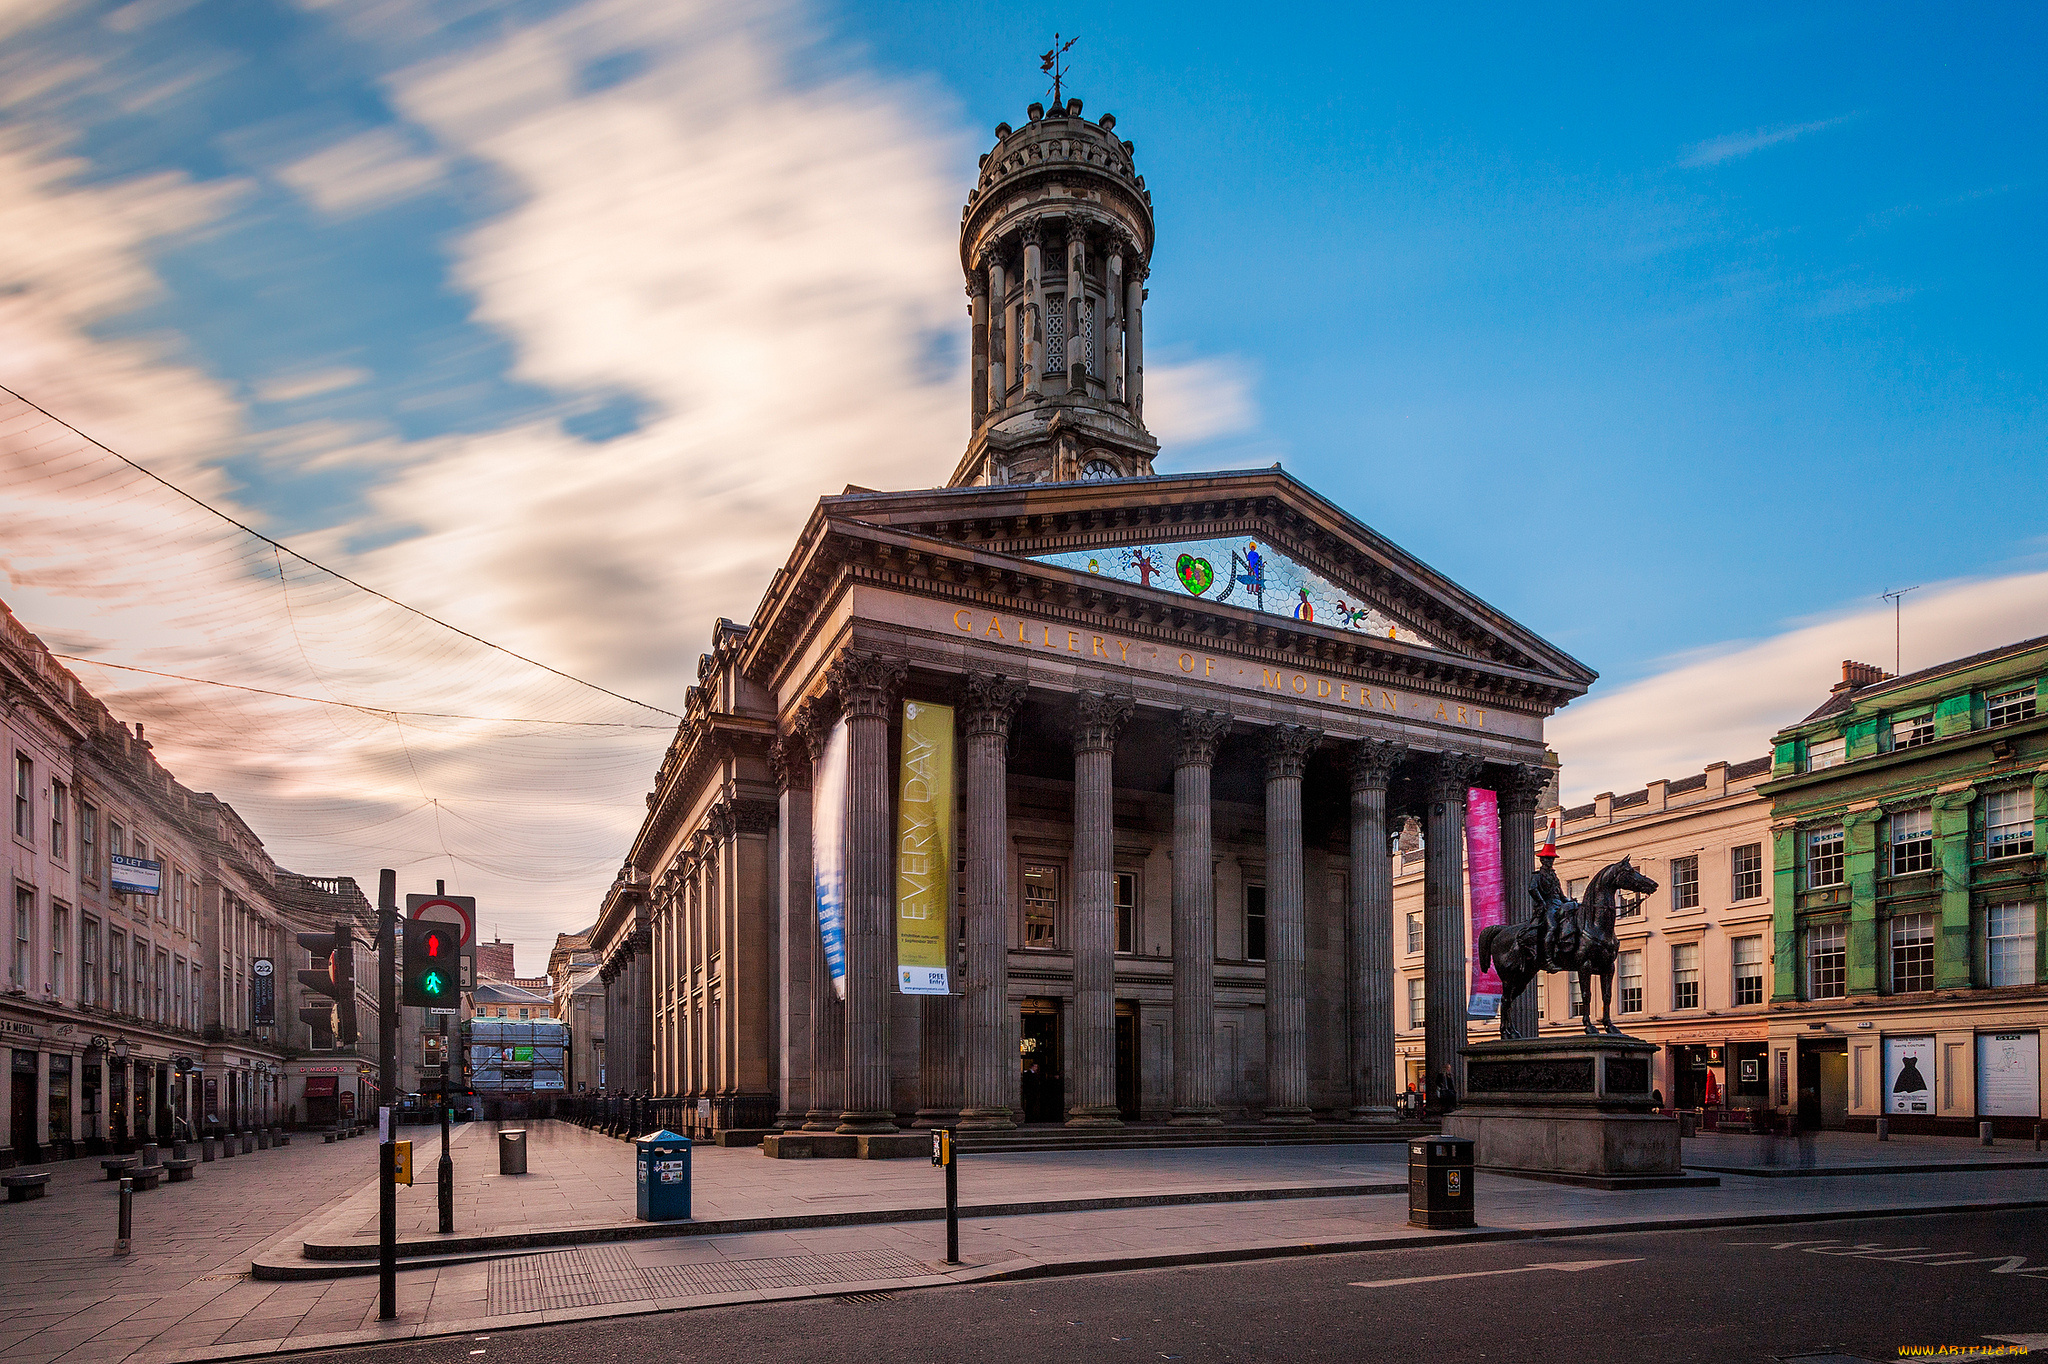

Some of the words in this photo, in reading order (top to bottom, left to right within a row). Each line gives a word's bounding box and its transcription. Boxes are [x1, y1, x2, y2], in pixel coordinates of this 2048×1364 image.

[953, 609, 1131, 663] GALLERY
[1178, 652, 1217, 678] OF
[1261, 668, 1398, 712] MODERN
[1434, 702, 1488, 728] ART
[903, 728, 939, 803] DAY
[111, 855, 124, 864] TO
[126, 858, 142, 867] LET
[901, 810, 937, 920] EVERY
[928, 972, 945, 980] FREE
[13, 1022, 34, 1035] MEDIA
[1720, 1238, 2048, 1280] NTRY
